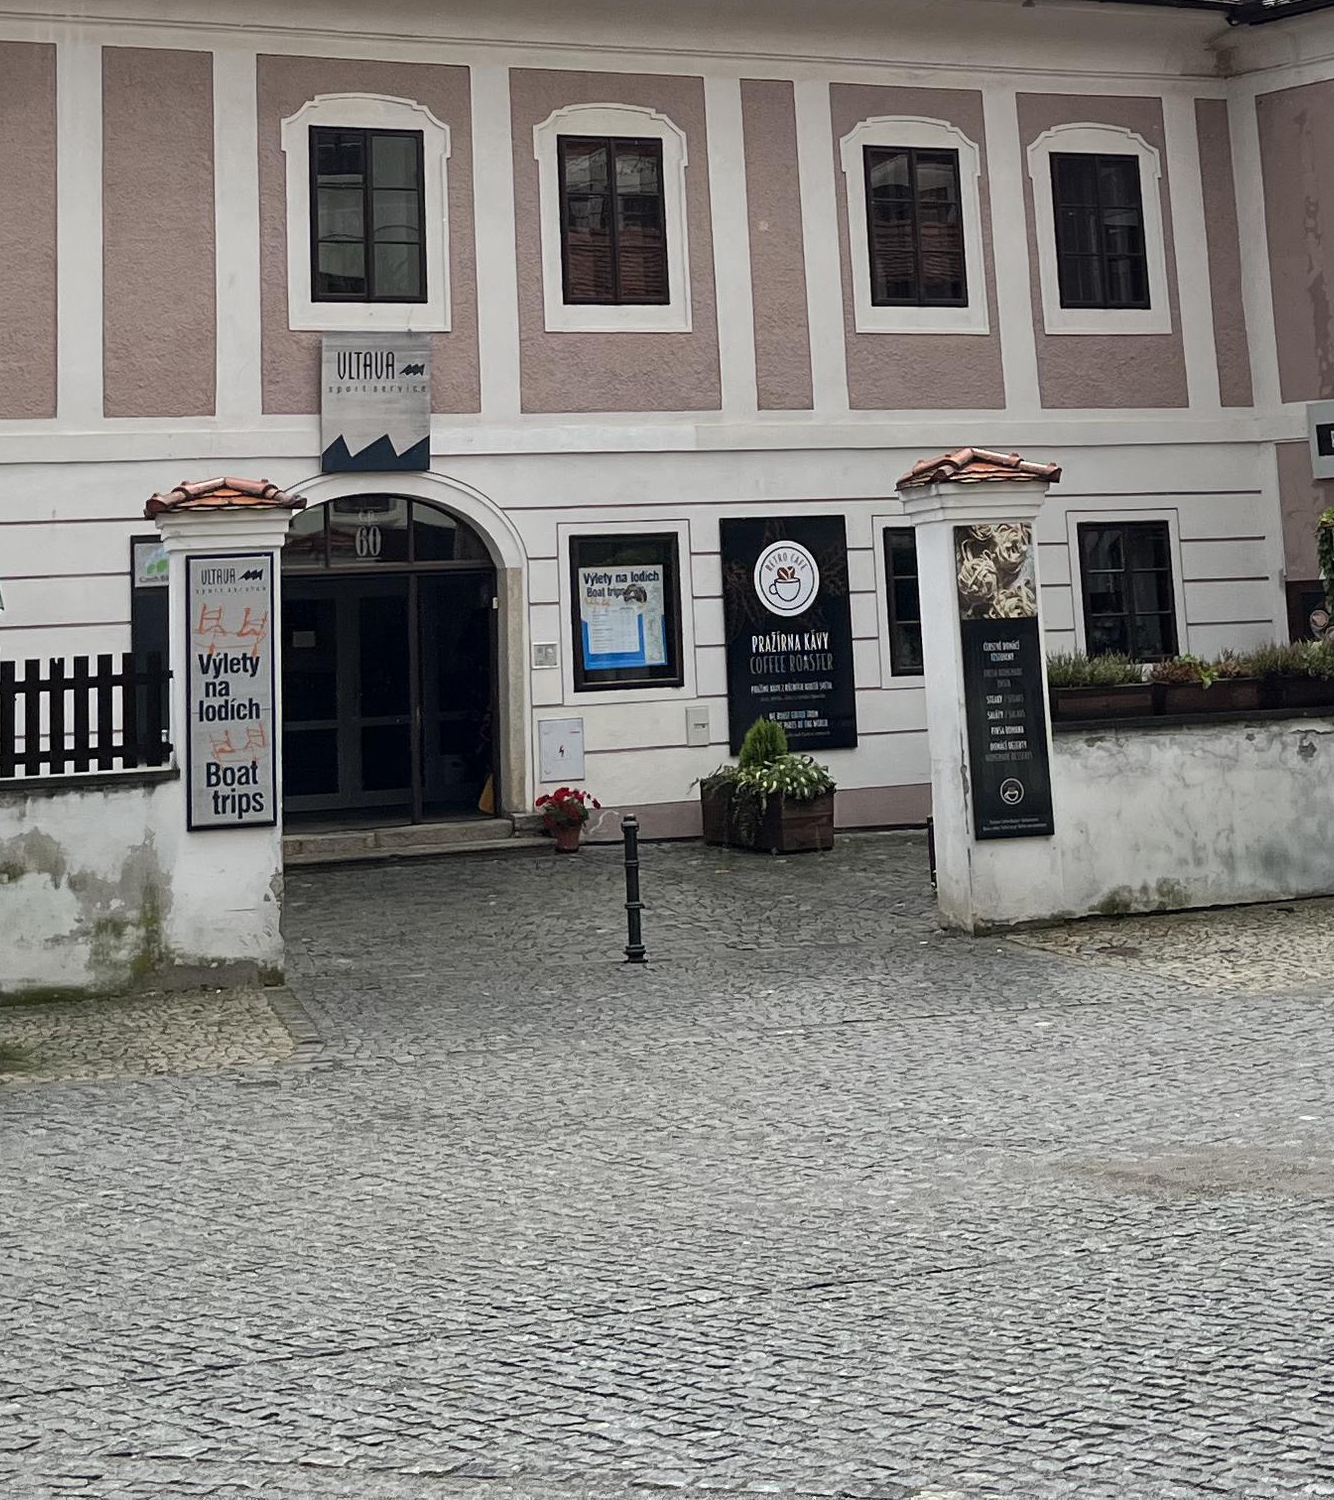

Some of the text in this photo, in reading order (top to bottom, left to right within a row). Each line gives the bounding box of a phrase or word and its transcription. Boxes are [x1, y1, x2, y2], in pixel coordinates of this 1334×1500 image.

[337, 351, 395, 380] VLTAVA
[355, 525, 381, 557] 60
[201, 568, 236, 586] VLTAVA
[616, 573, 628, 583] na
[751, 629, 829, 653] PRAŽÍRNA KÁVY
[198, 652, 260, 679] Výlety
[749, 652, 834, 675] COFFEE ROASTER
[205, 680, 230, 698] na
[198, 698, 261, 722] lodích
[206, 760, 259, 788] Boat
[212, 788, 264, 819] trips
